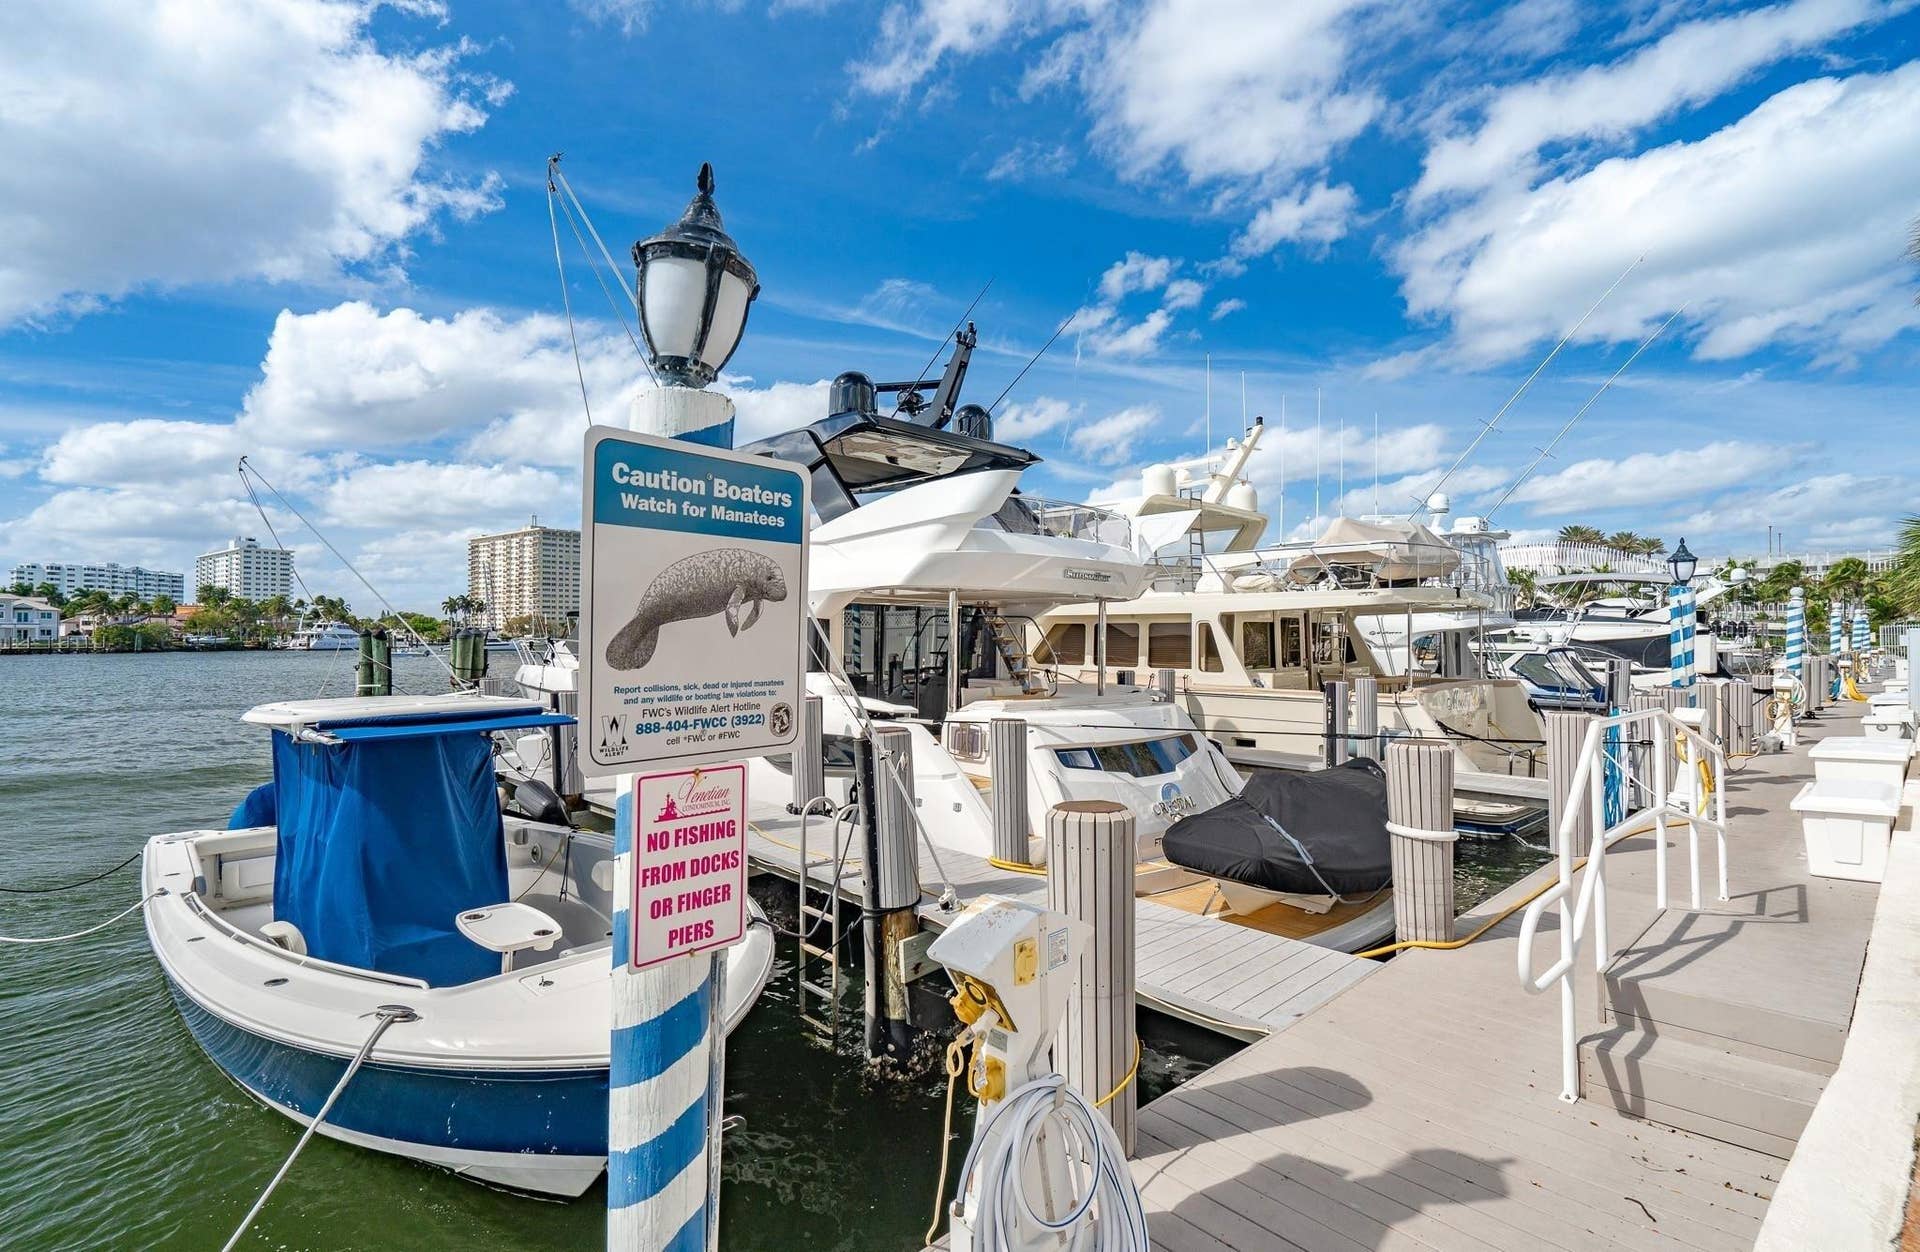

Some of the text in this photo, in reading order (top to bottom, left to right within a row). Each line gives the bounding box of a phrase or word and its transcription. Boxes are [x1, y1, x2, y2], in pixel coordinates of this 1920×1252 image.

[612, 462, 792, 507] Caution Boaters
[621, 493, 785, 527] Watch for Manatees
[614, 686, 641, 695] Report
[644, 683, 681, 693] collisions,
[683, 682, 700, 691] sick,
[730, 681, 752, 689] injured
[624, 697, 639, 705] and
[641, 697, 655, 705] any
[657, 694, 683, 703] wildlife
[694, 692, 721, 701] boating
[736, 690, 767, 698] violations
[635, 716, 727, 735] 888-404-FWCC
[731, 713, 765, 728] (3922)
[642, 702, 761, 718] FWC's Wildlife Alert Hotline
[600, 745, 628, 753] WILDLIFE
[666, 736, 681, 746] cell
[718, 730, 741, 740] #FWC
[678, 776, 730, 804] Venetian
[647, 819, 736, 853] NO FISHING
[641, 850, 740, 888] FROM DOCKS
[650, 883, 731, 920] OR FINGER
[668, 919, 714, 949] PIERS
